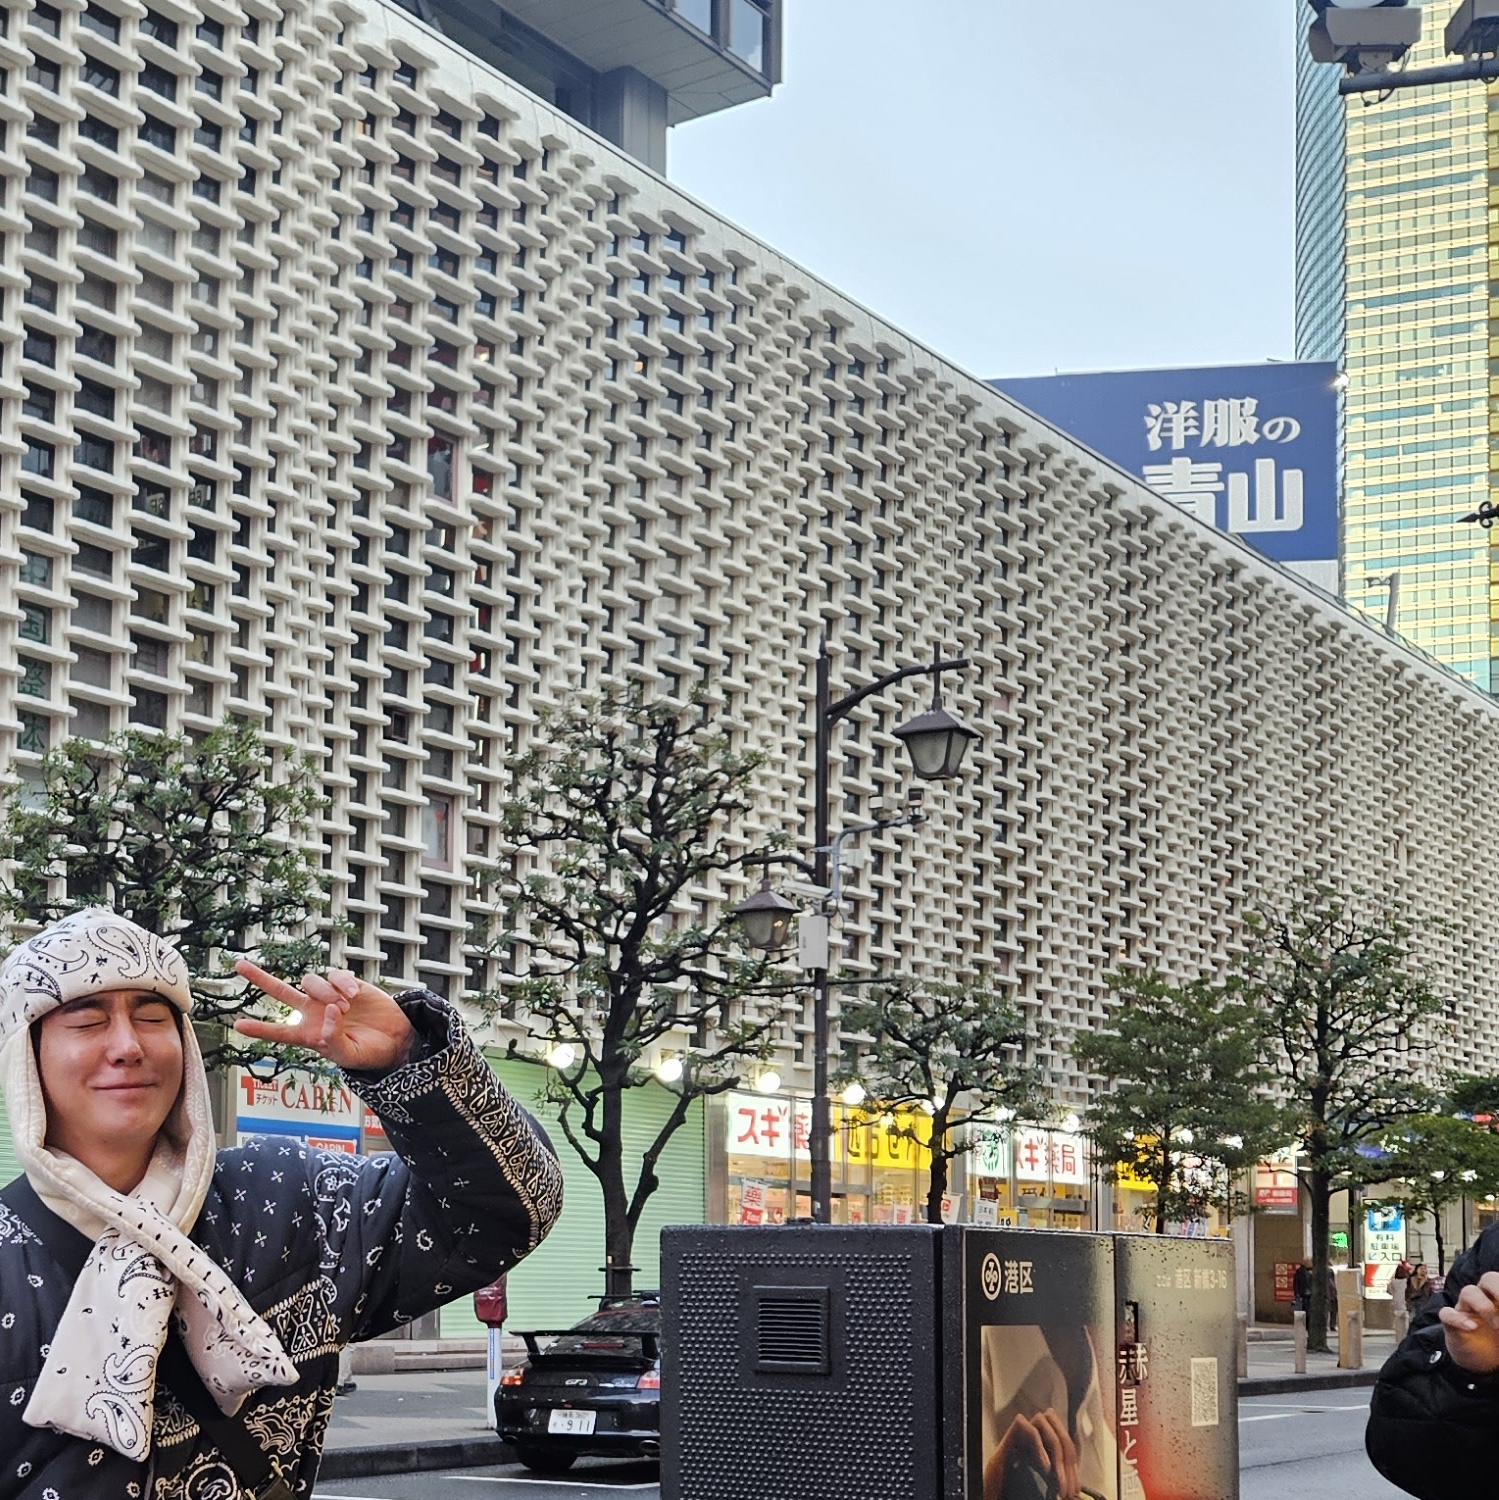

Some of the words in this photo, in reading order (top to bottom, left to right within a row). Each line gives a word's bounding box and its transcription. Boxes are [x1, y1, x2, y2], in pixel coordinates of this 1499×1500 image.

[1144, 397, 1301, 451] 洋服の
[1142, 457, 1303, 533] 青山
[256, 1093, 278, 1106] チケット
[281, 1084, 353, 1114] CABIN
[738, 1105, 810, 1150] スギ薬
[1005, 1260, 1034, 1294] 港区
